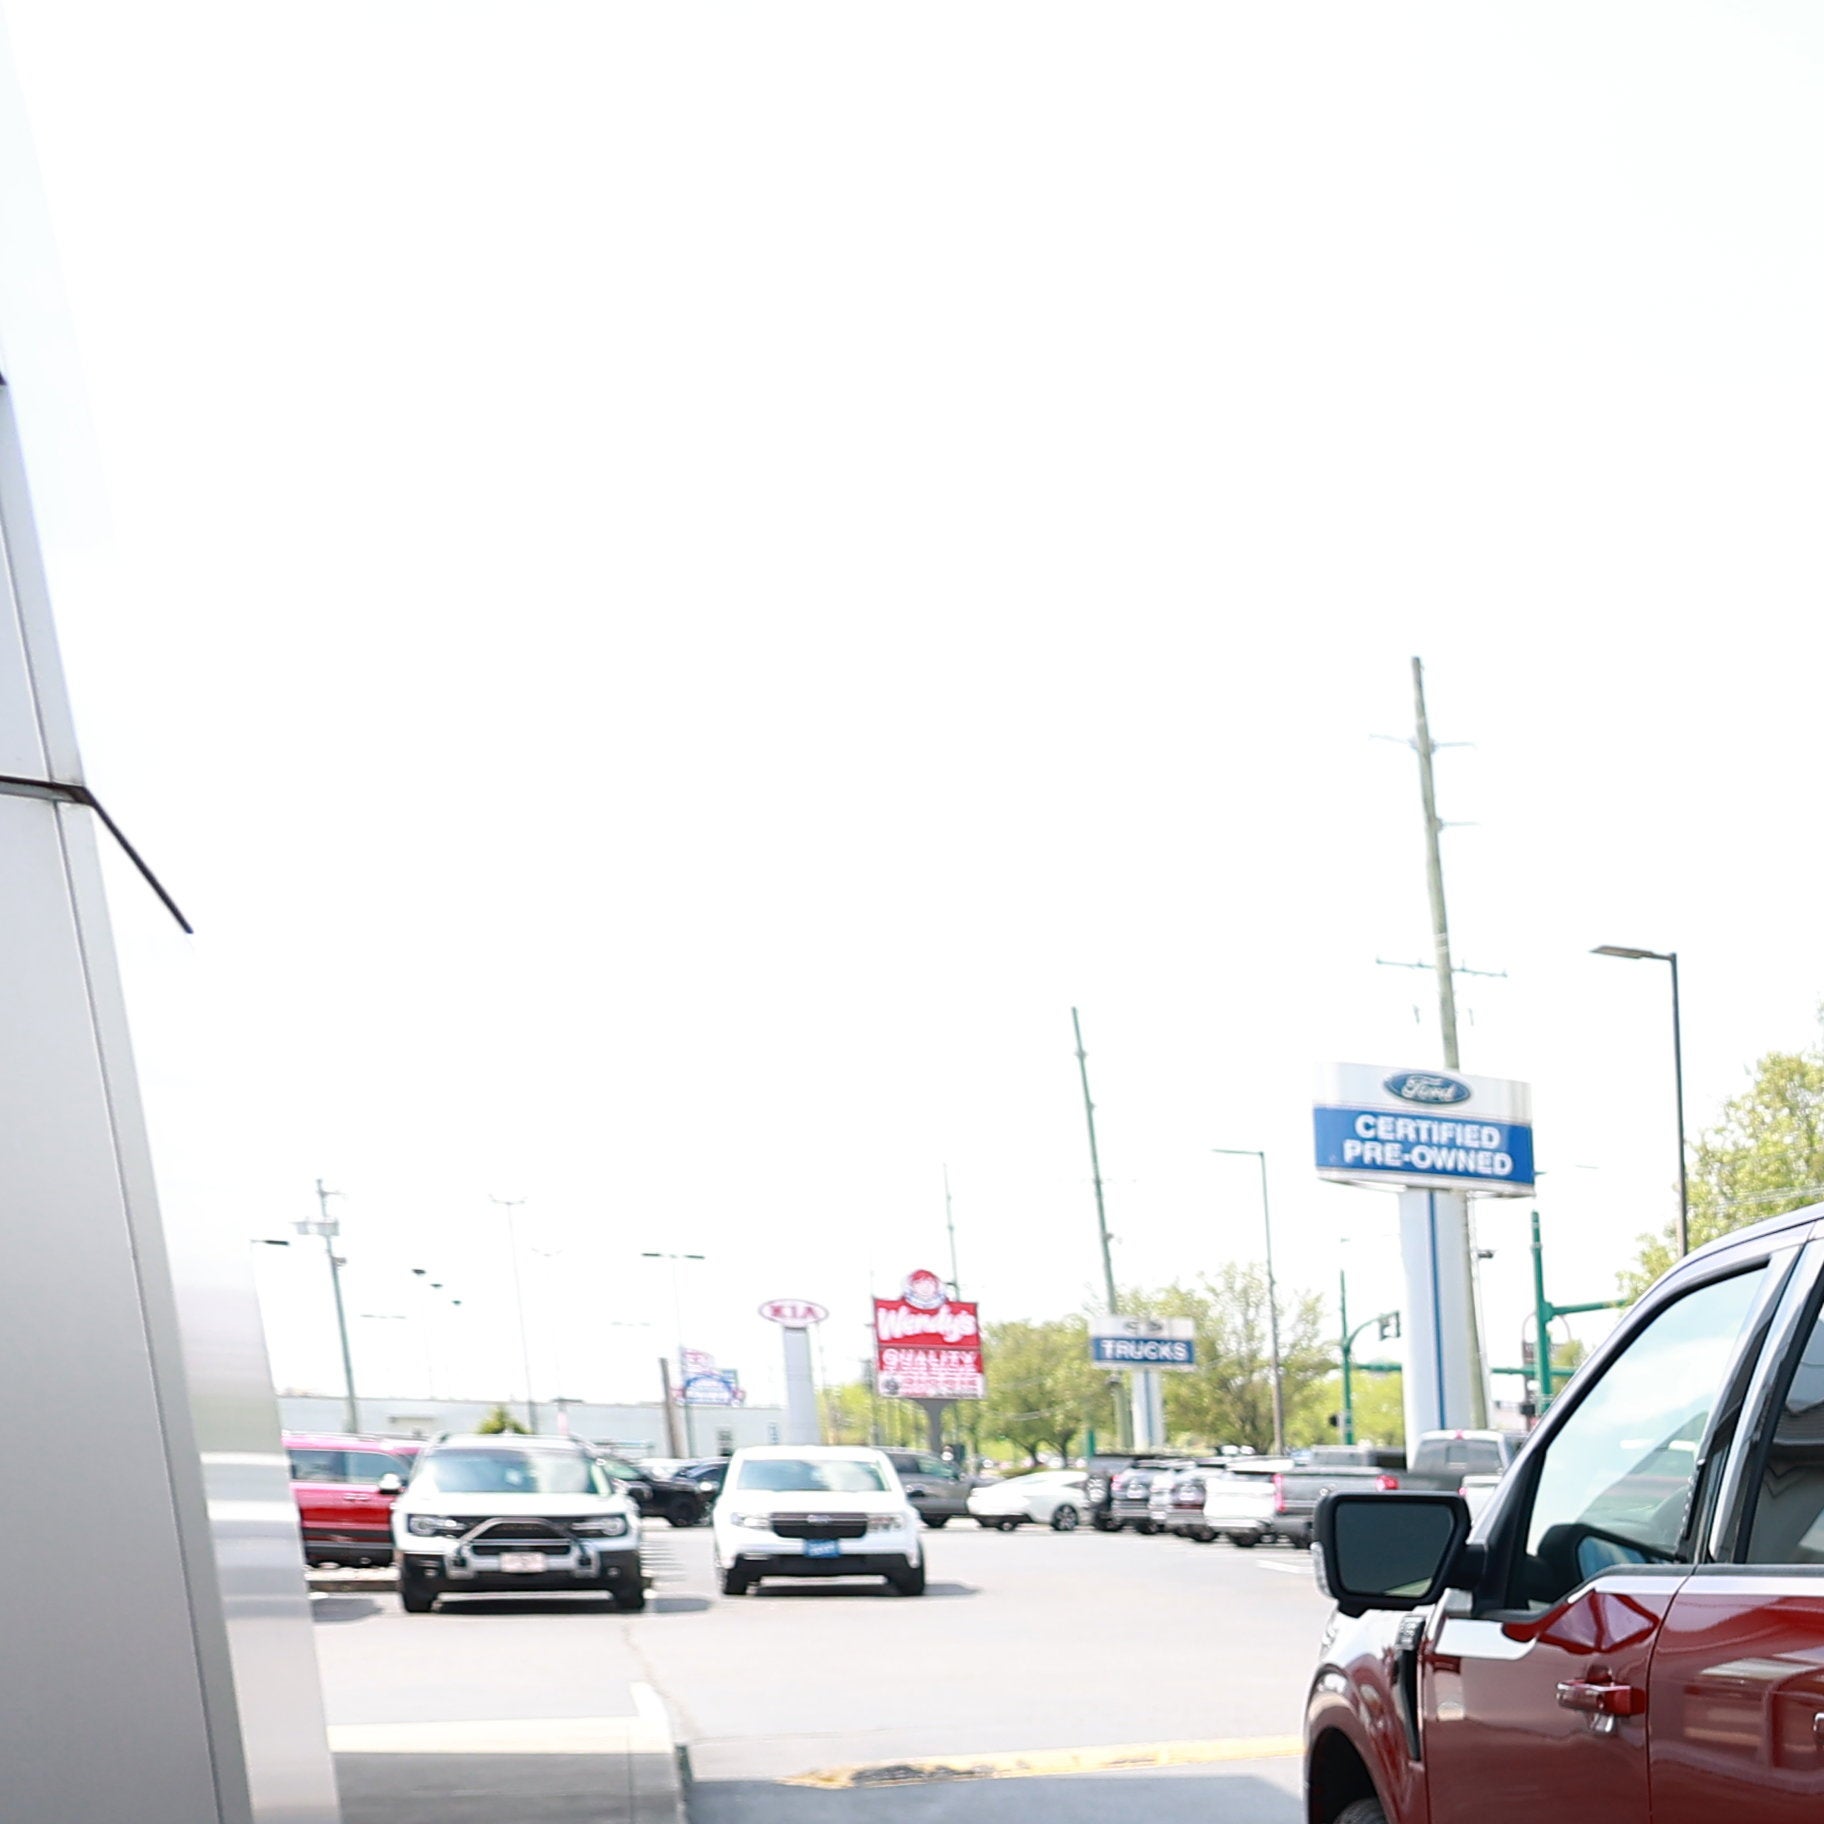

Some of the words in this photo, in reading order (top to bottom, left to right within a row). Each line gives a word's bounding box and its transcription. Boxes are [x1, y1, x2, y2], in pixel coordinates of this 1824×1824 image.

[1401, 1075, 1457, 1101] Ford
[1355, 1114, 1501, 1149] CERTIFIED
[1343, 1139, 1513, 1176] PRE-OWNED
[769, 1305, 818, 1319] KIA
[877, 1305, 977, 1342] Wendy's
[882, 1348, 977, 1364] QUALITY
[1101, 1339, 1188, 1361] TRUCKS
